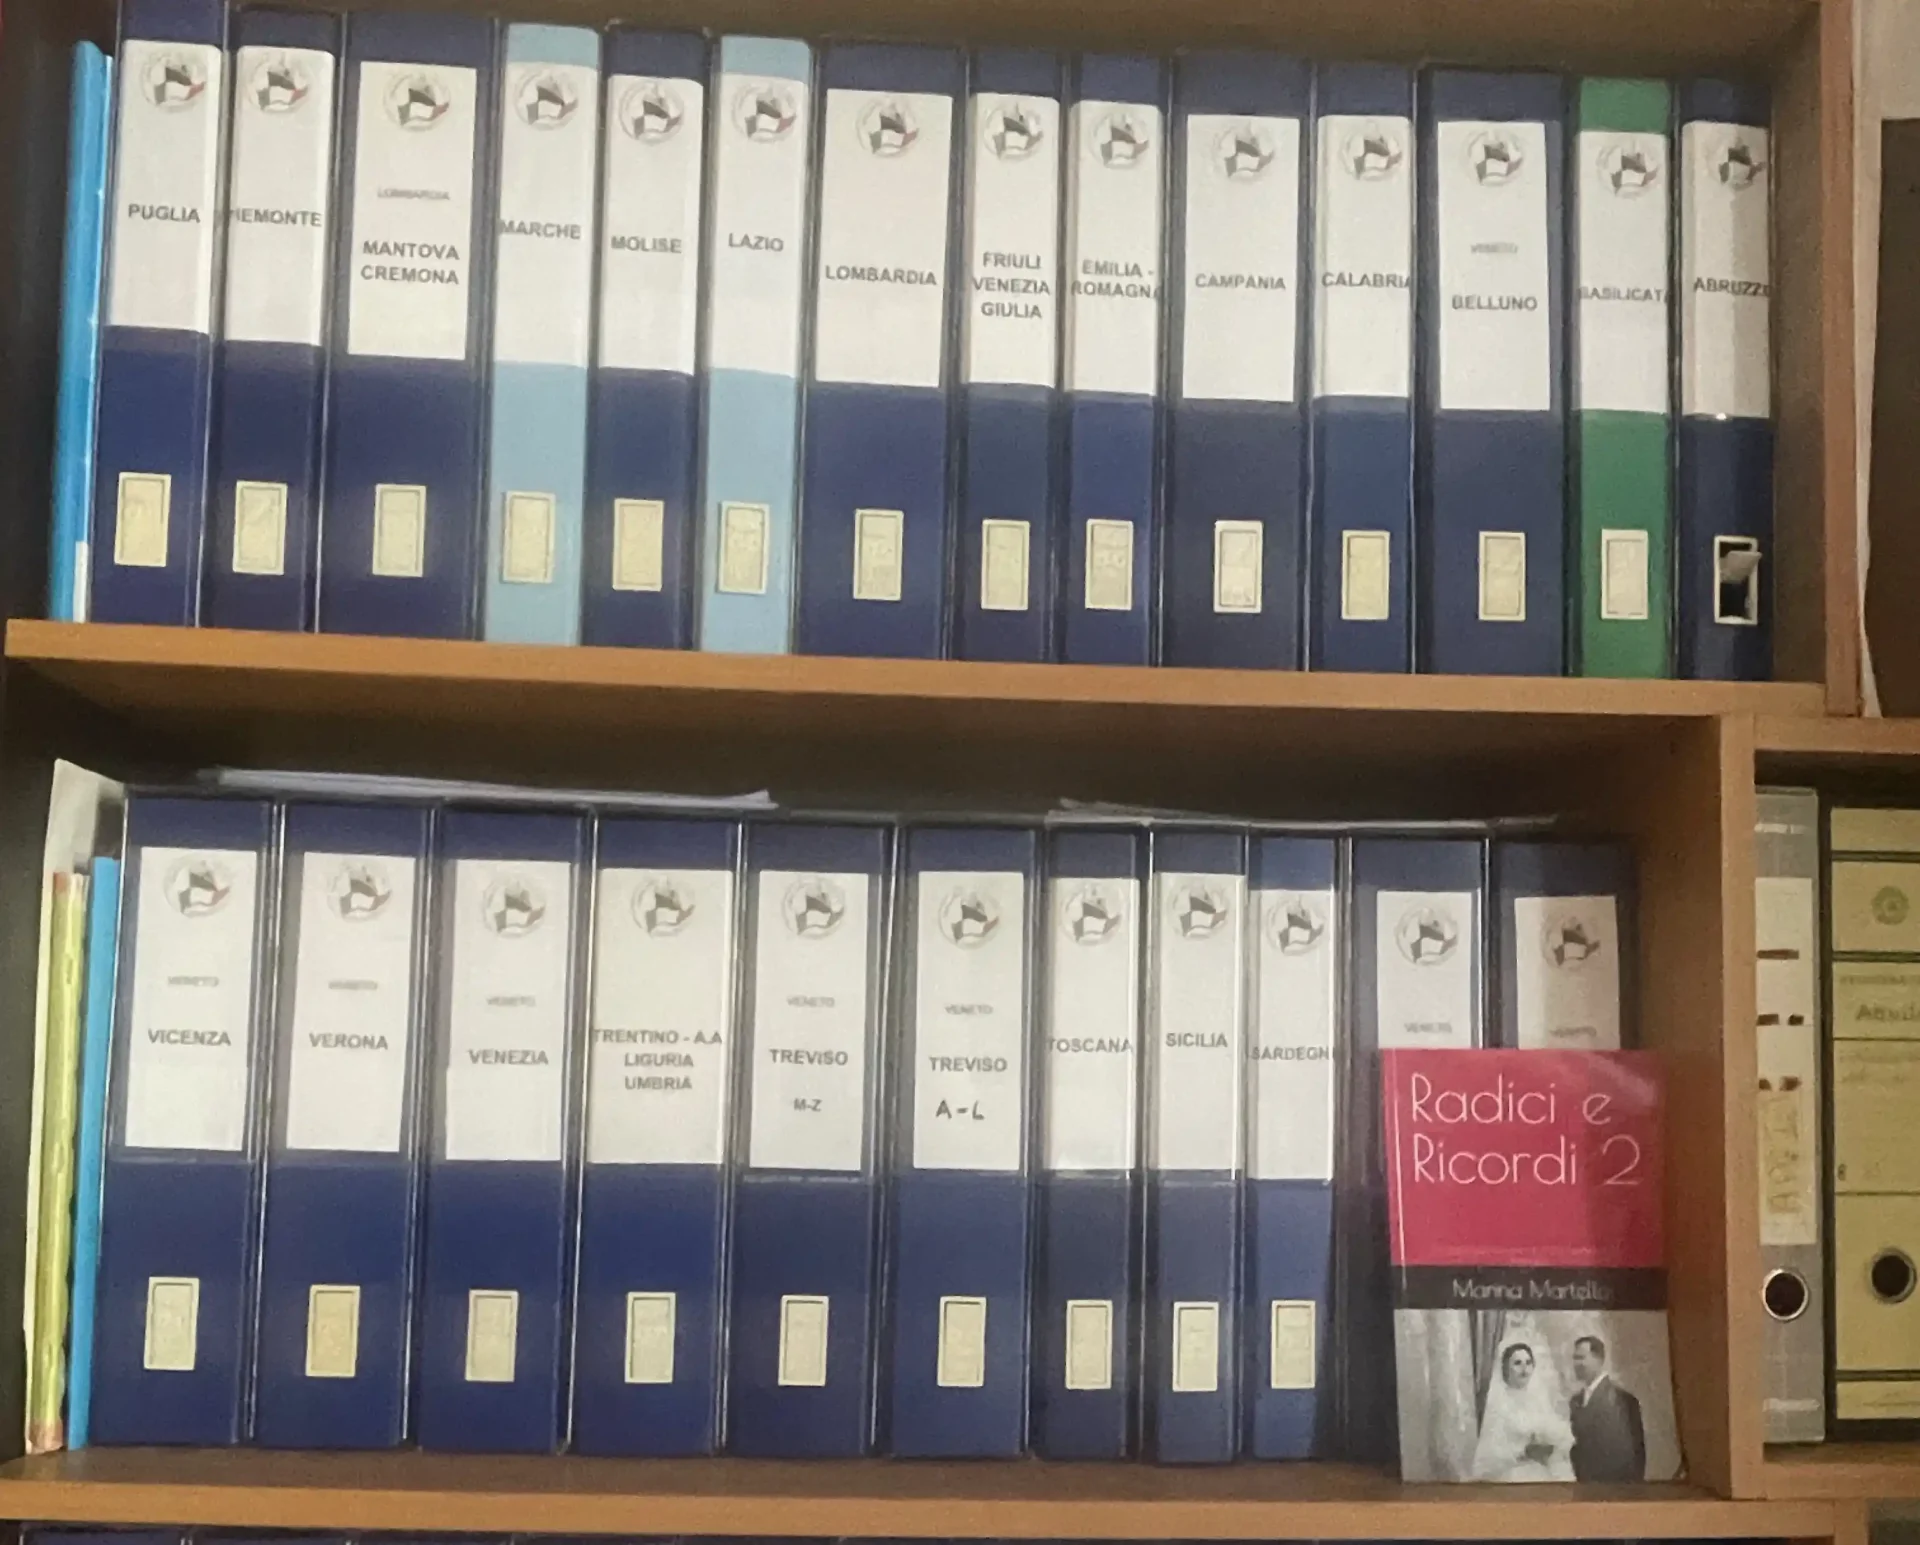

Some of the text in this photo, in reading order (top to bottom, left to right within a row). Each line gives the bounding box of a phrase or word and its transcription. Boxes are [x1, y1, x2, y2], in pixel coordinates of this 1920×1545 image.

[128, 204, 200, 223] PUGLIA
[498, 218, 581, 240] MARCHE
[363, 240, 460, 260] MANTOVA
[611, 234, 682, 253] MOLISE
[728, 232, 784, 252] LAZIO
[982, 251, 1042, 270] FRIULI
[1082, 259, 1142, 277] EMILIA
[361, 265, 459, 285] CREMONA
[825, 264, 938, 287] LOMBARDIA
[1195, 273, 1287, 291] CAMPANIA
[972, 276, 1050, 296] VENEZIA
[981, 300, 1043, 319] GIULIA
[1452, 294, 1538, 311] BELLUNO
[148, 1028, 231, 1047] VICENZA
[309, 1032, 388, 1050] VERONA
[593, 1028, 679, 1044] TRENTINO
[1165, 1031, 1229, 1049] SICILIA
[1048, 1037, 1134, 1055] TOSCANA
[1247, 1045, 1334, 1062] SARDEGN
[468, 1048, 549, 1066] VENEZIA
[624, 1052, 694, 1068] LIGURIA
[769, 1048, 849, 1066] TREVISO
[929, 1056, 1008, 1073] TREVISO
[624, 1076, 692, 1090] UMBRIA
[1411, 1073, 1613, 1126] Radici e
[1412, 1133, 1641, 1187] Ricordi 2
